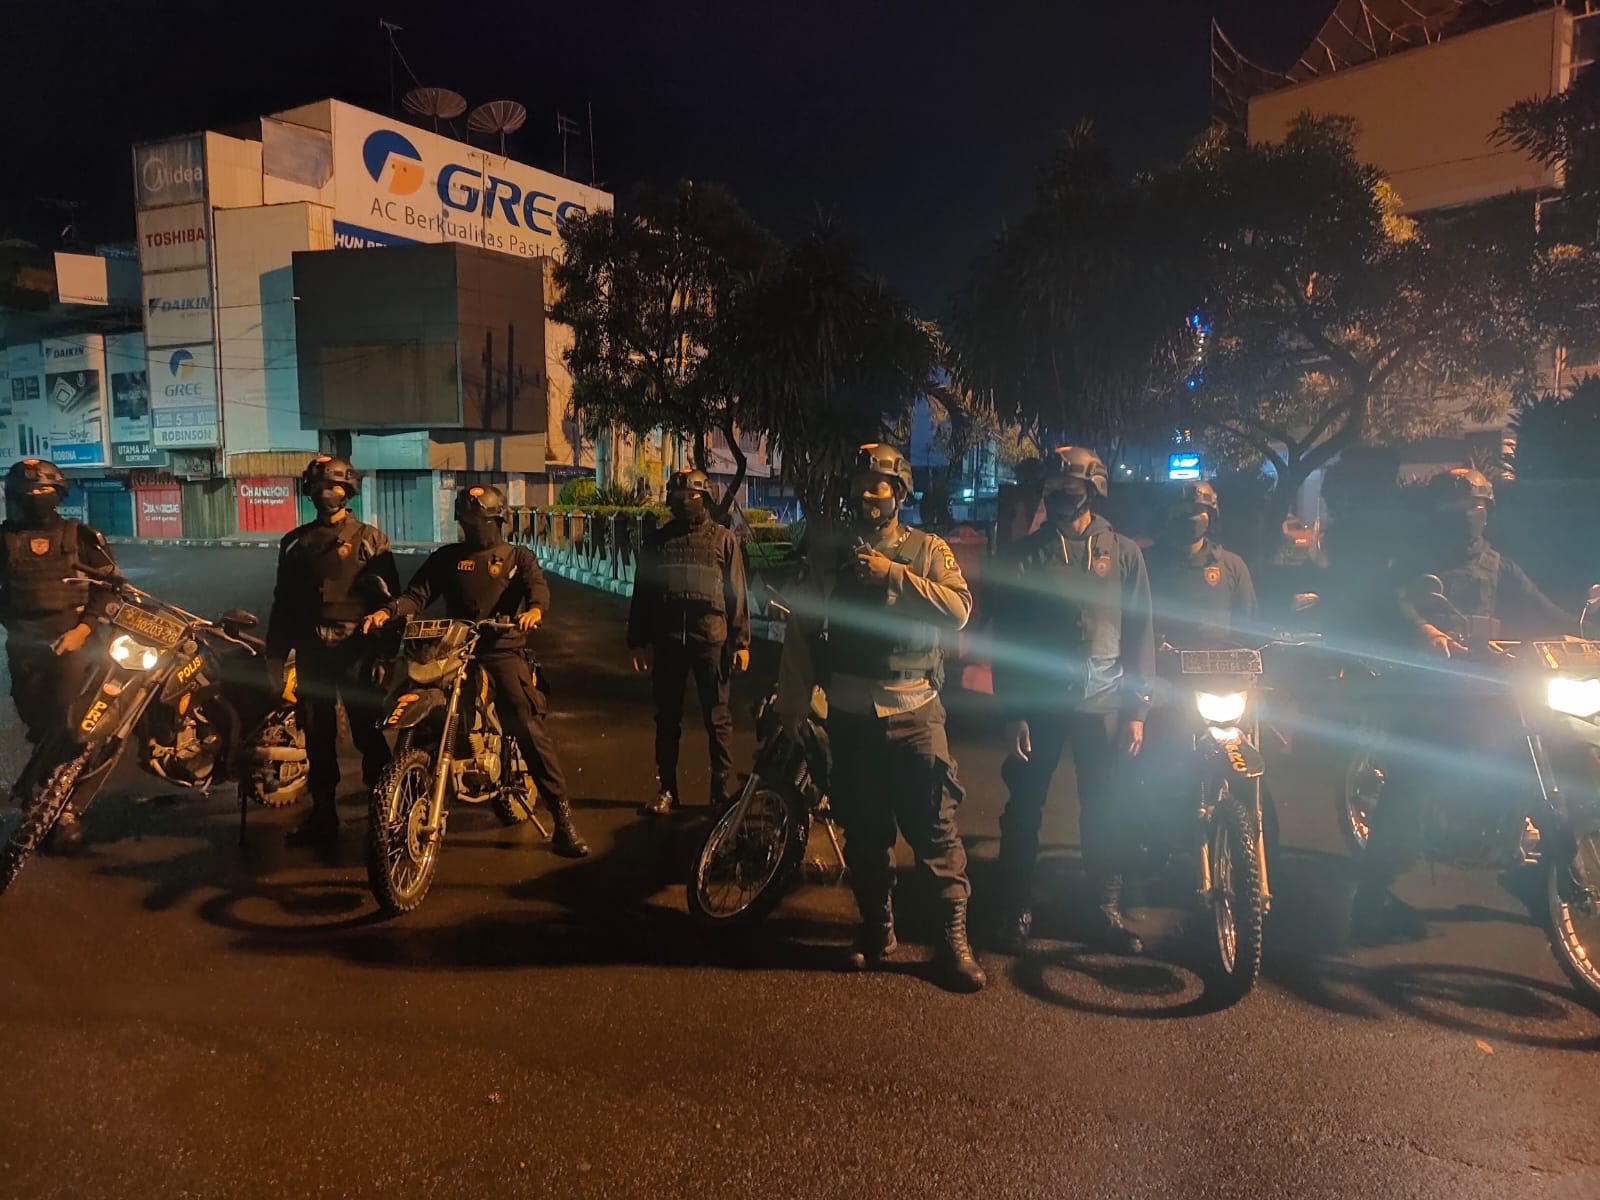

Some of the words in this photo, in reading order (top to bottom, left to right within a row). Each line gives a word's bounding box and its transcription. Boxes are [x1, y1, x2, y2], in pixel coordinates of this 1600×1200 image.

[371, 197, 398, 221] AC
[405, 205, 504, 249] Berkualitas
[509, 234, 545, 257] Pasti
[145, 228, 205, 249] TOSHIBA
[161, 296, 211, 312] DAIKIN
[53, 346, 84, 358] DAIKIN
[161, 429, 212, 441] ROBINSON
